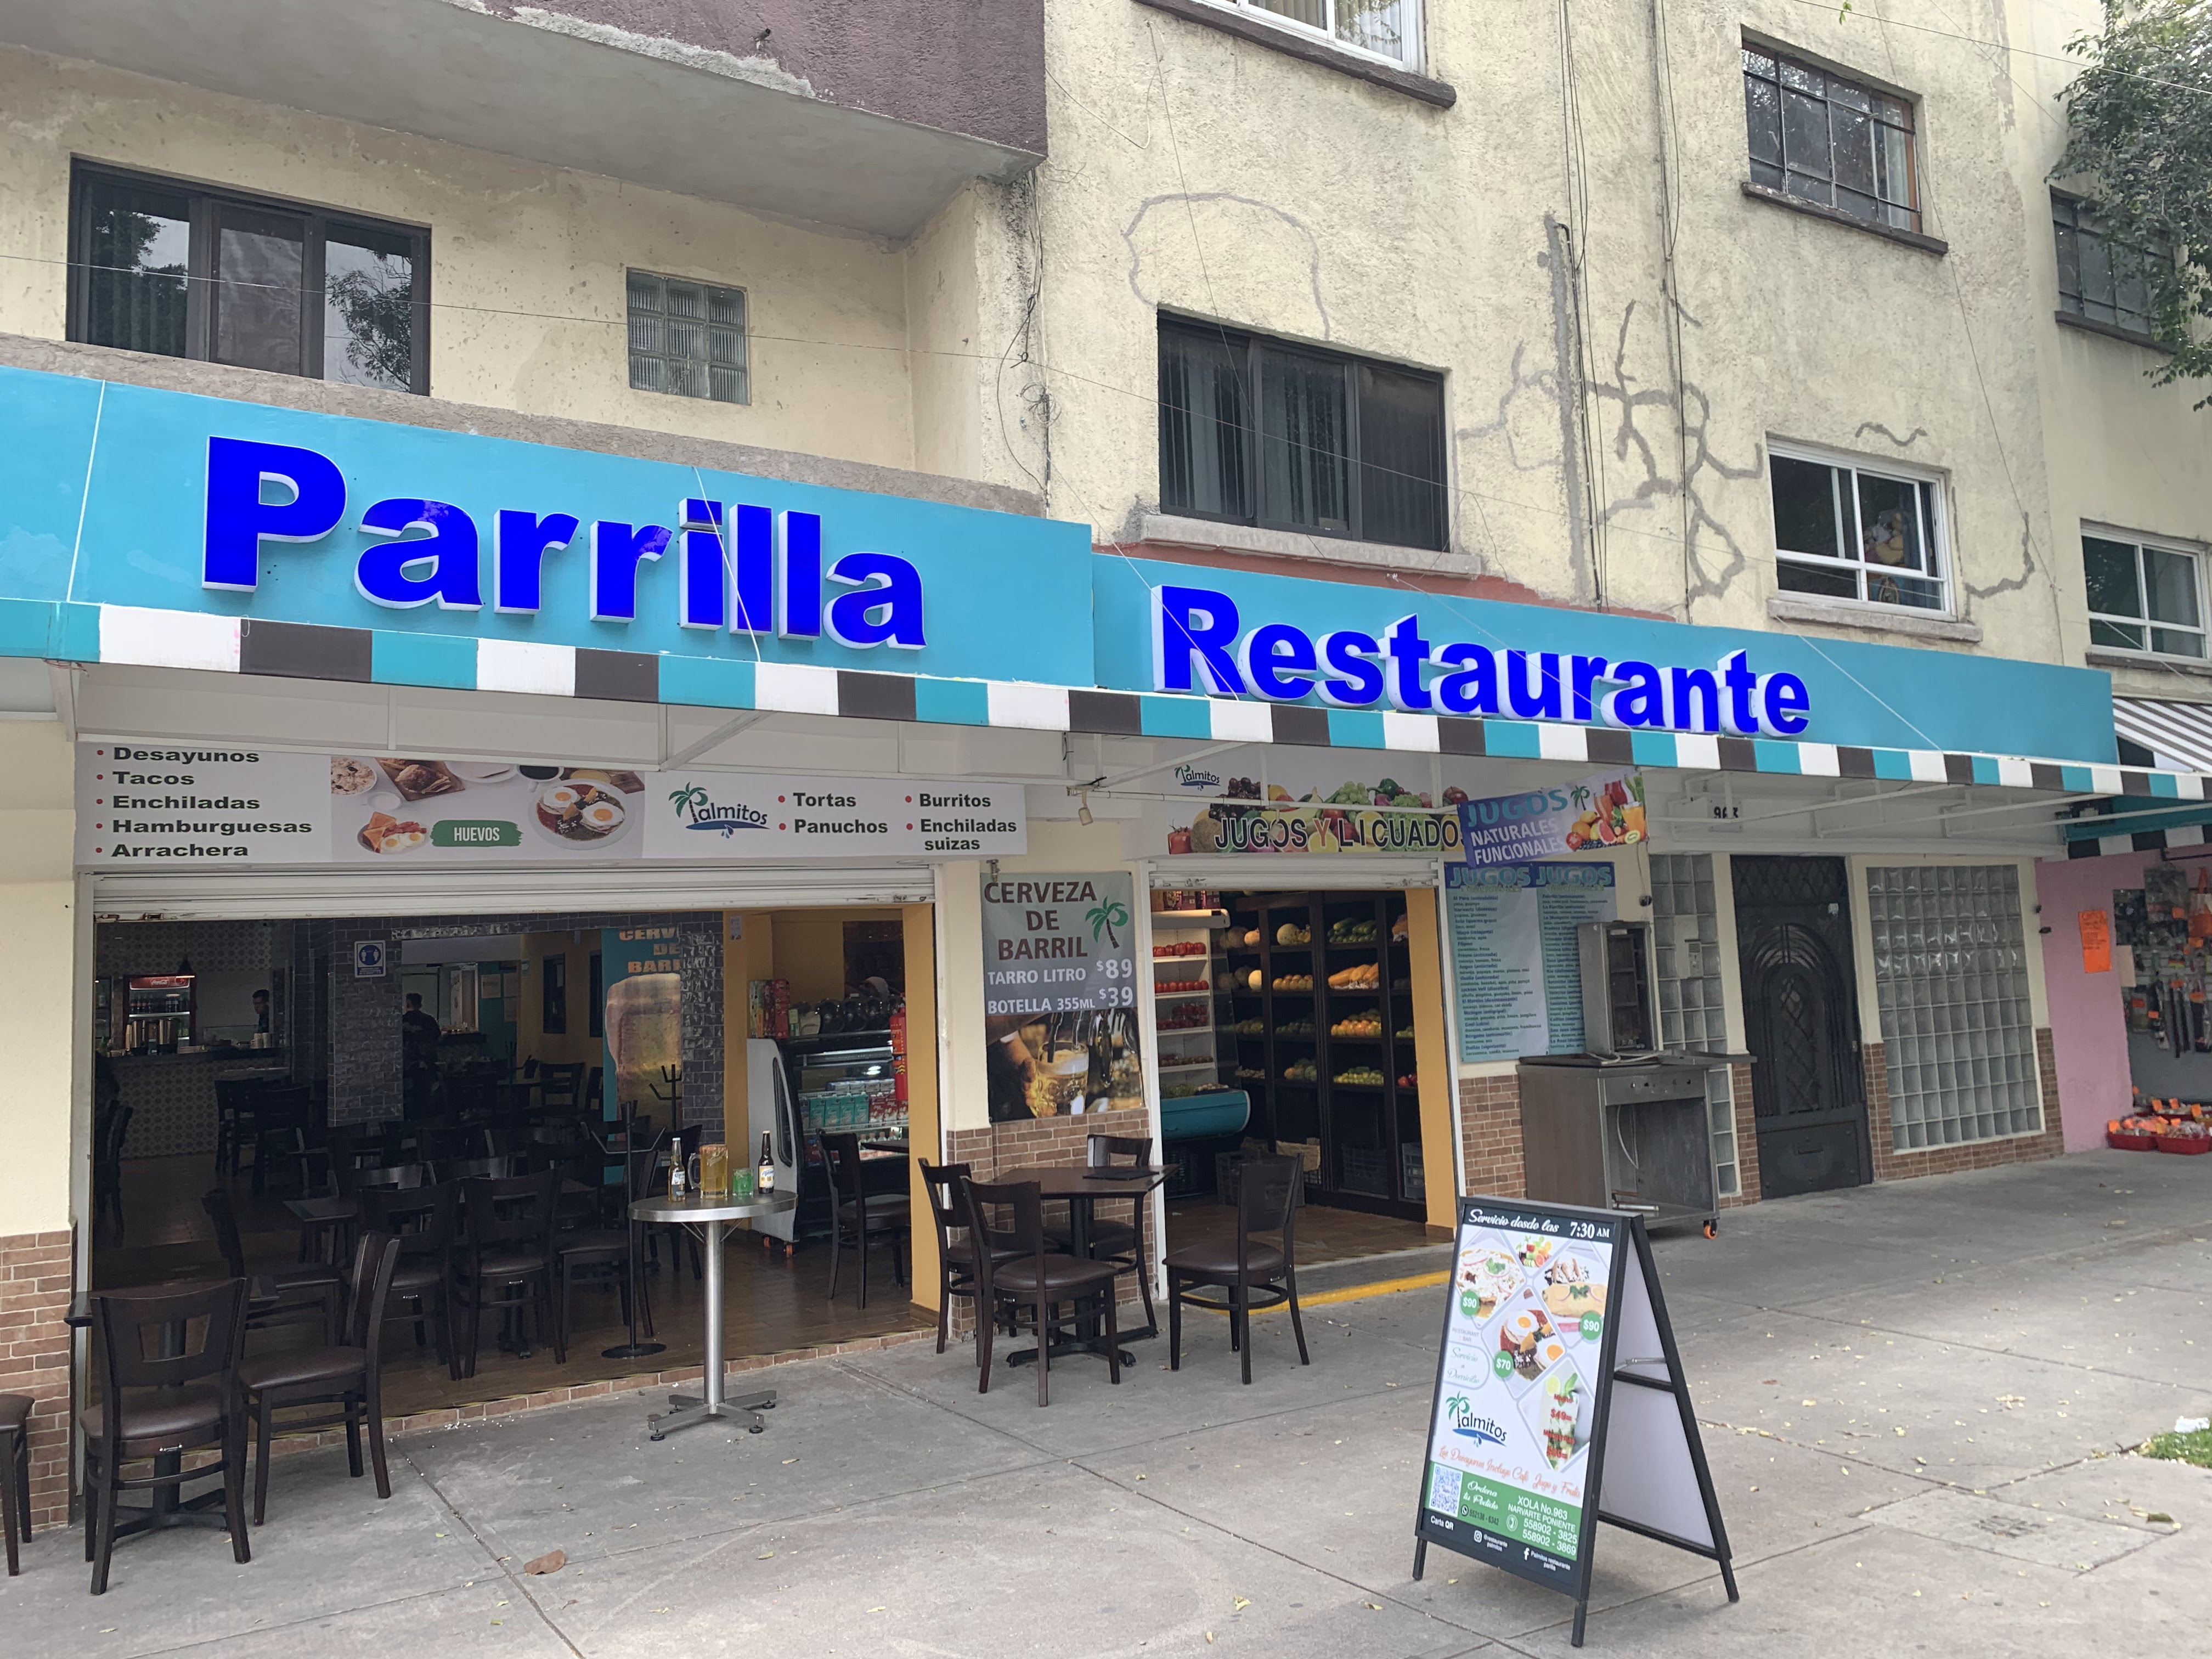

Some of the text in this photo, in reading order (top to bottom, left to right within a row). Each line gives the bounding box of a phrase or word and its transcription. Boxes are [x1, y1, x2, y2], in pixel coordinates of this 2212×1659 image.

[201, 435, 927, 651] Parrilla
[1151, 584, 1811, 738] Restaurante
[113, 747, 259, 765] Desayunos
[113, 771, 195, 786] Tacos
[113, 795, 261, 810] Enchiladas
[793, 793, 856, 808] Tortas
[919, 793, 991, 808] Burritos
[1468, 789, 1568, 827] JUGOS
[112, 819, 312, 837] Hamburguesas
[454, 827, 500, 843] HUEVOS
[795, 820, 888, 834] Panuchos
[921, 819, 1017, 833] Enchiladas
[1215, 817, 1464, 848] JUGOS Y LICUADO
[1471, 818, 1558, 847] NATURALES
[112, 843, 249, 857] Arrachera
[924, 837, 980, 851] suizas
[1475, 836, 1564, 865] FUNCIONALES
[1450, 866, 1531, 887] JUGOS
[1536, 866, 1612, 887] JUGOS
[984, 881, 1097, 903] CERVEZA
[1026, 910, 1059, 931] DE
[619, 928, 675, 941] CERV
[998, 936, 1088, 960] BARRIL
[988, 958, 1132, 985] TARRO LITRO $89
[988, 986, 1133, 1014] BOTELLA 355ML $39
[1469, 1209, 1610, 1239] Servicio desde las 7:30 AM
[1463, 1296, 1477, 1308] $90
[1452, 1328, 1479, 1337] RESTAURANT
[1583, 1319, 1600, 1332] $90
[1452, 1347, 1478, 1362] Servicio
[1496, 1357, 1511, 1370] $70
[1448, 1368, 1480, 1384] Domicilio
[1468, 1481, 1498, 1497] Ordena
[1473, 1494, 1498, 1510] Pedido
[1517, 1495, 1568, 1520] XOLA No.963
[1431, 1515, 1454, 1531] Carta QR
[1508, 1503, 1576, 1533] NARVARTE PONIENTE
[1523, 1518, 1551, 1536] 558902
[1558, 1530, 1577, 1544] 3825
[1522, 1529, 1550, 1547] 558902
[1556, 1541, 1576, 1556] 3869
